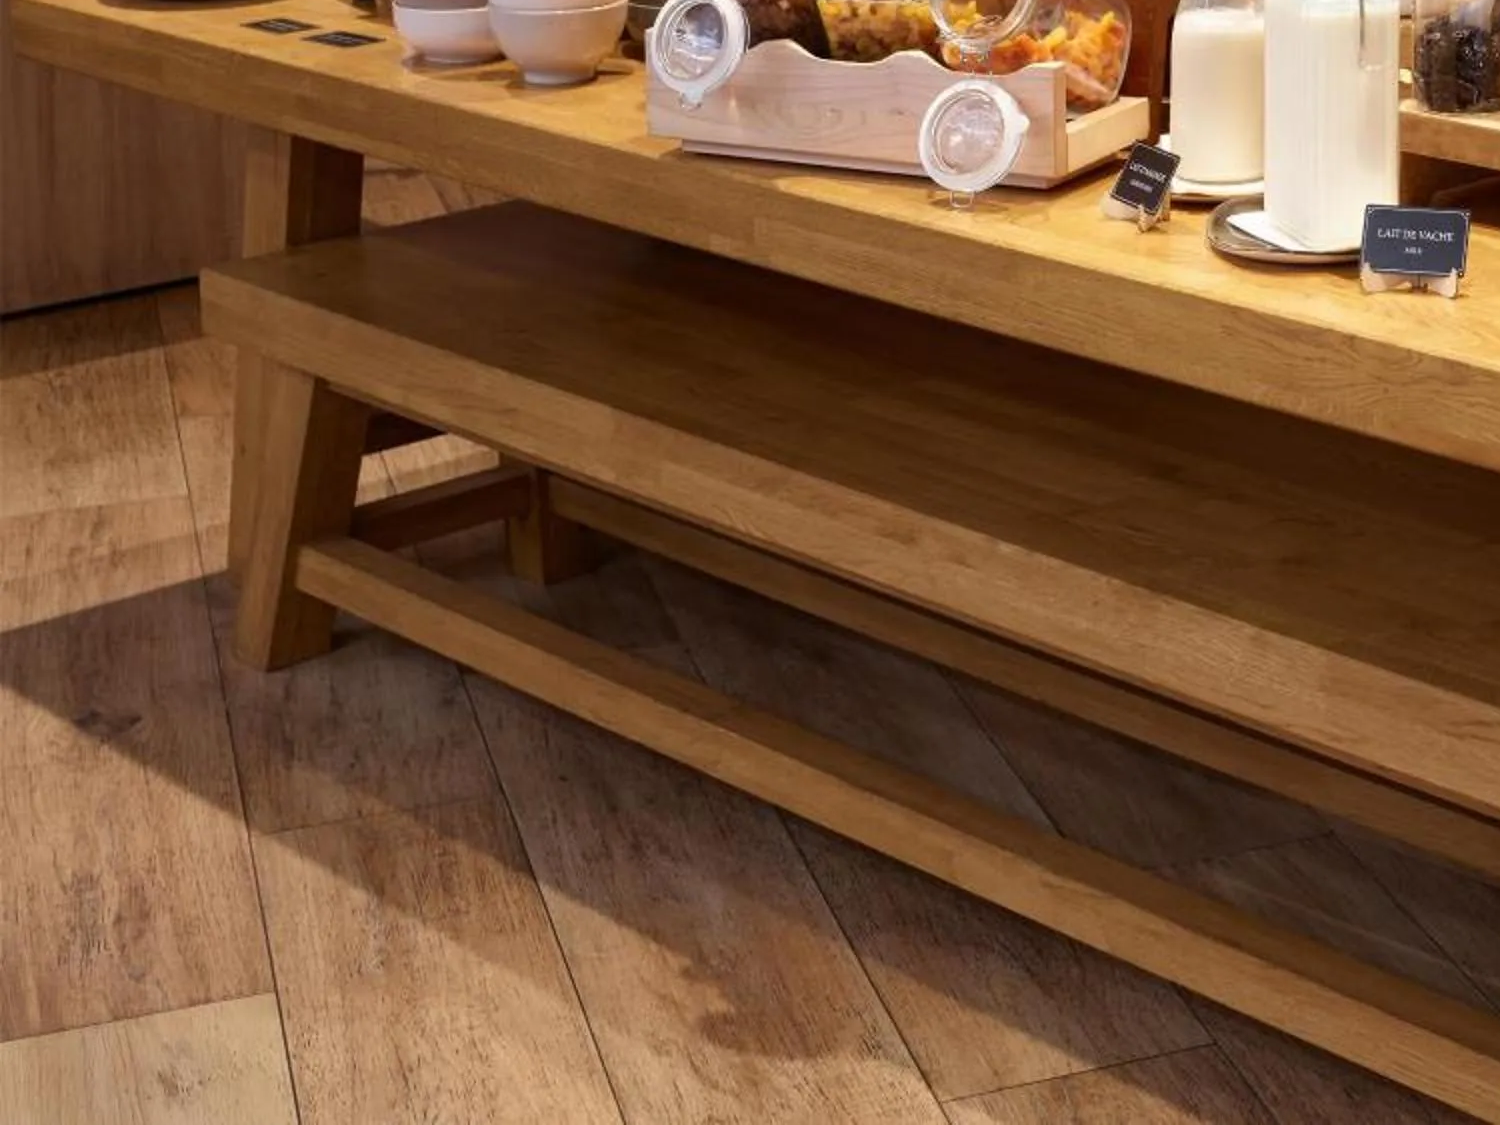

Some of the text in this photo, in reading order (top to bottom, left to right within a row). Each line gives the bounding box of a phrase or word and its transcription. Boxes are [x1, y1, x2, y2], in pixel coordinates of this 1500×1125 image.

[1377, 227, 1455, 242] LAIT DE VACHE
